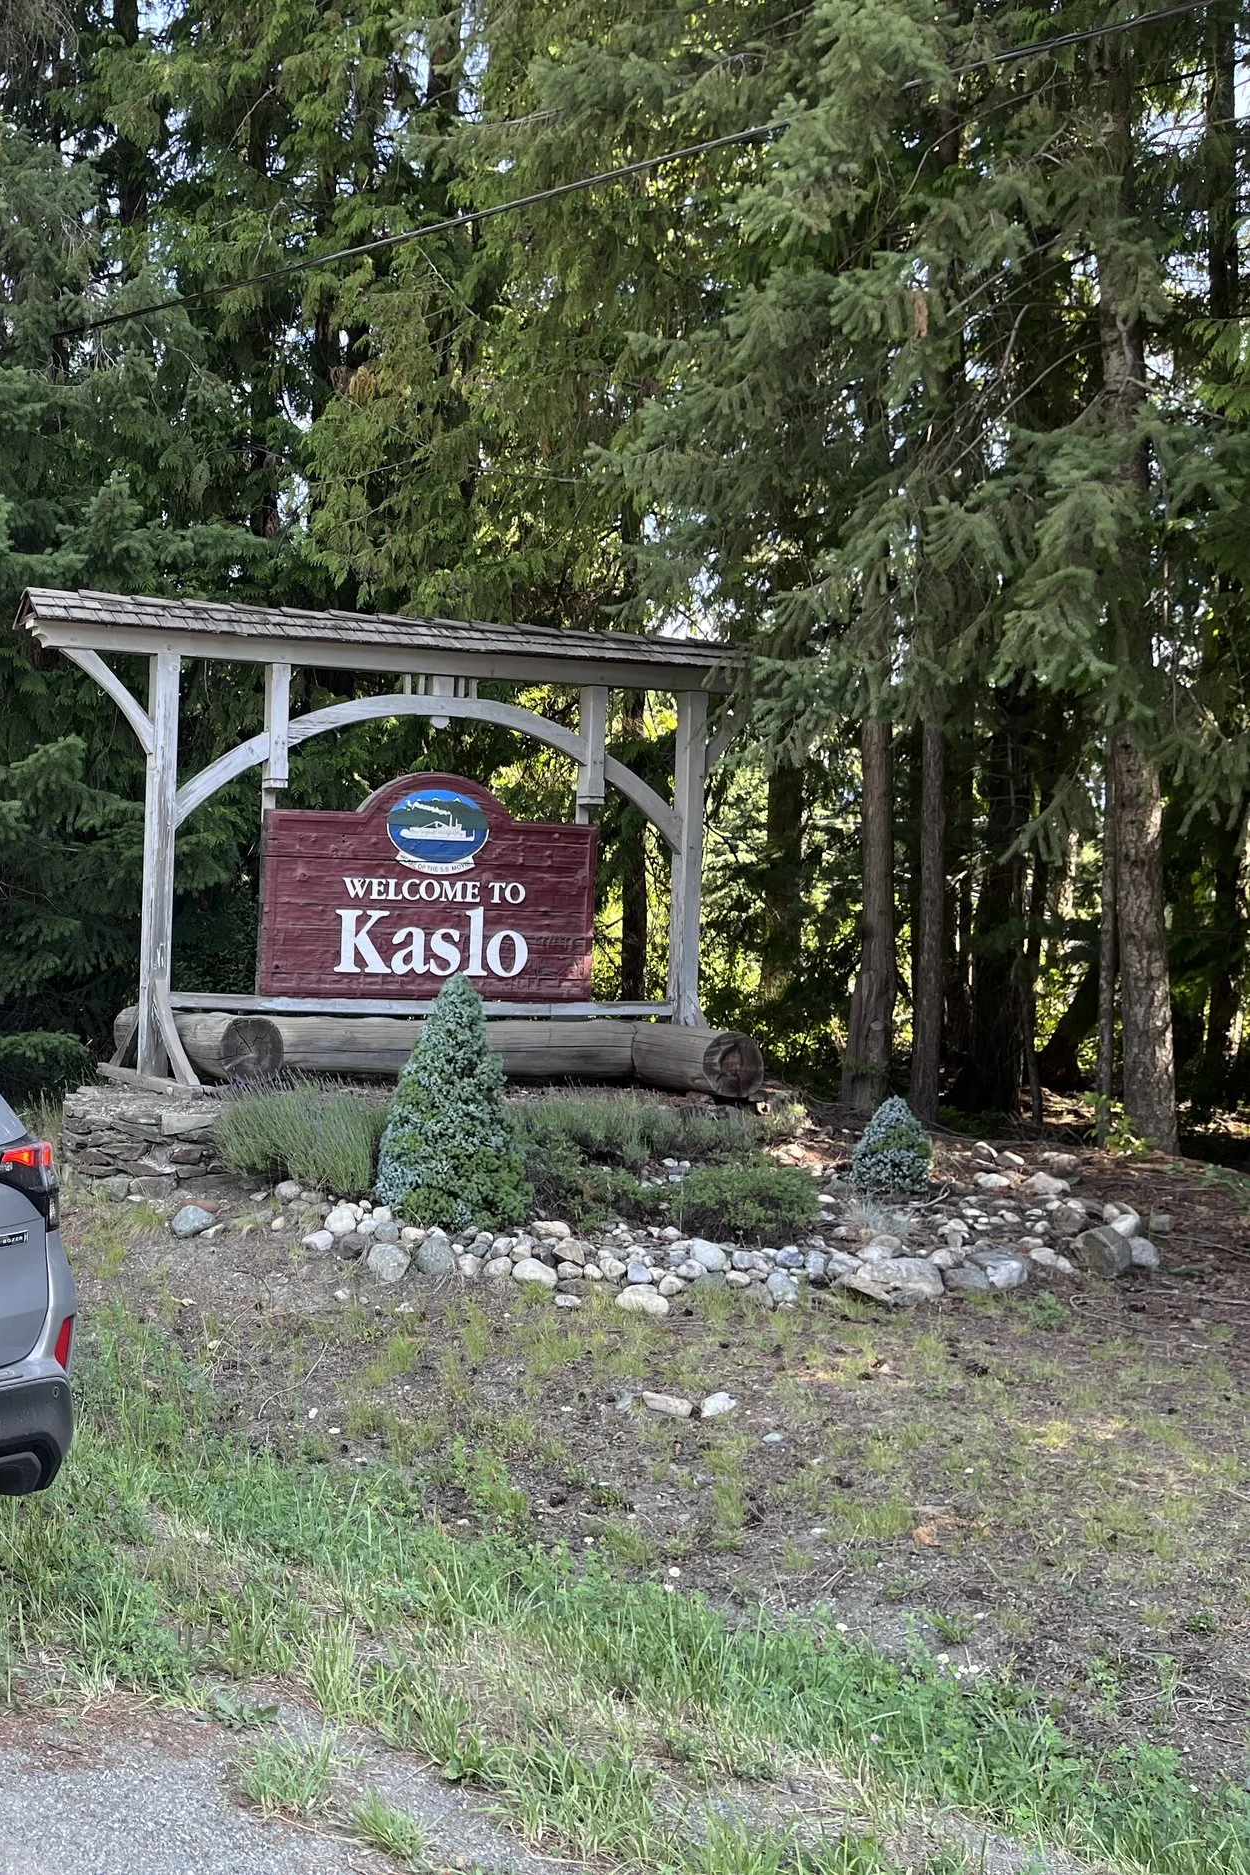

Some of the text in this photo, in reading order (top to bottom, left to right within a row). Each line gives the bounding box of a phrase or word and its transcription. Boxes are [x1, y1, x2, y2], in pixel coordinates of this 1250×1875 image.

[343, 877, 526, 904] WELCOME TO
[333, 906, 529, 978] Kaslo
